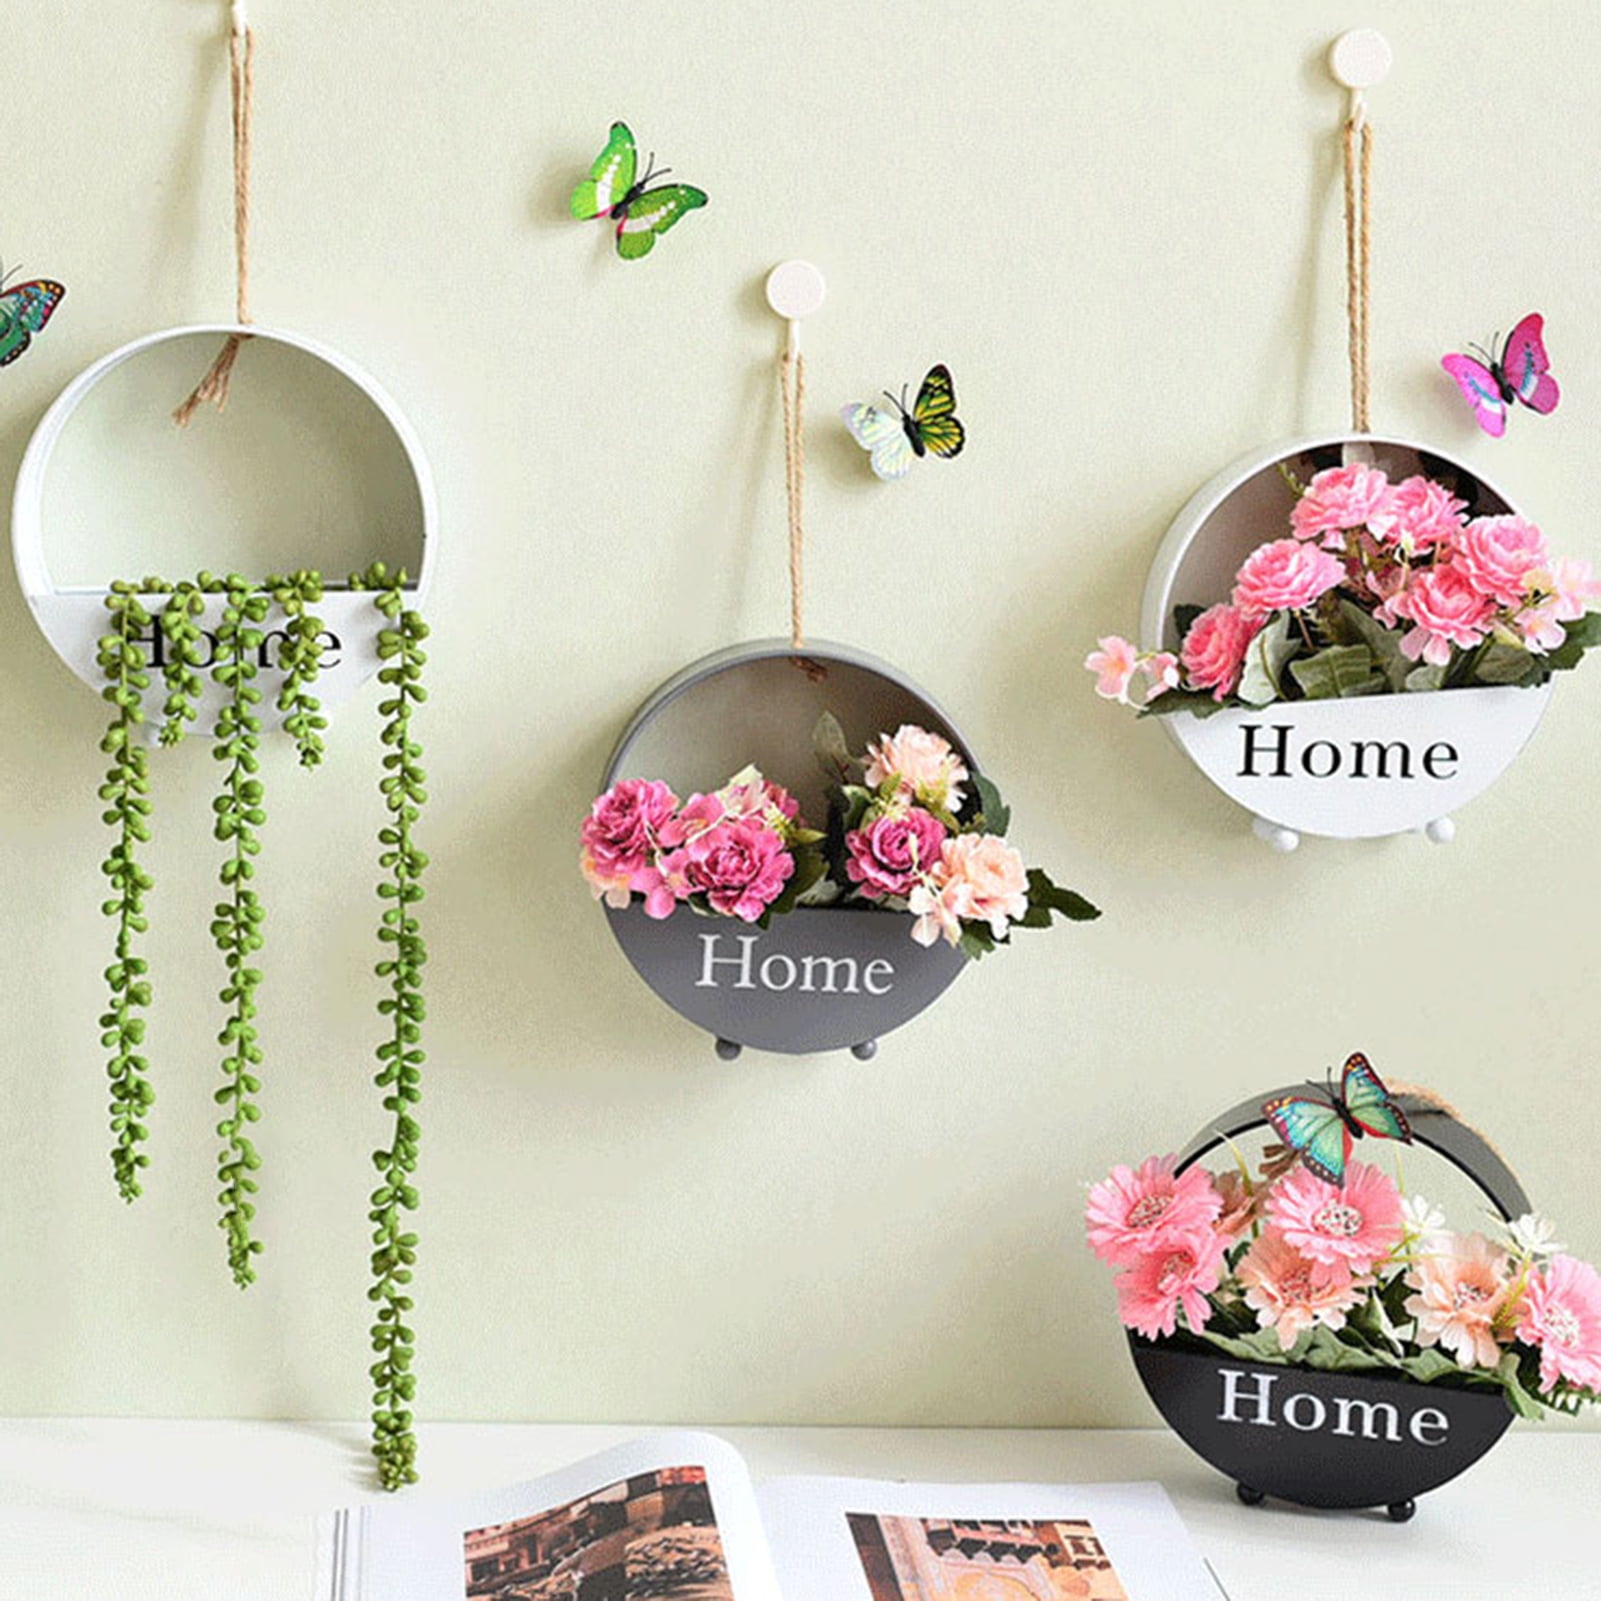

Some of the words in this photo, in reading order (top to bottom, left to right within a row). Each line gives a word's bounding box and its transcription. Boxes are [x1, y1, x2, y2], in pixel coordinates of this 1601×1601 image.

[1236, 724, 1459, 779] Home
[695, 933, 894, 994] Home
[1217, 1369, 1449, 1445] Home
